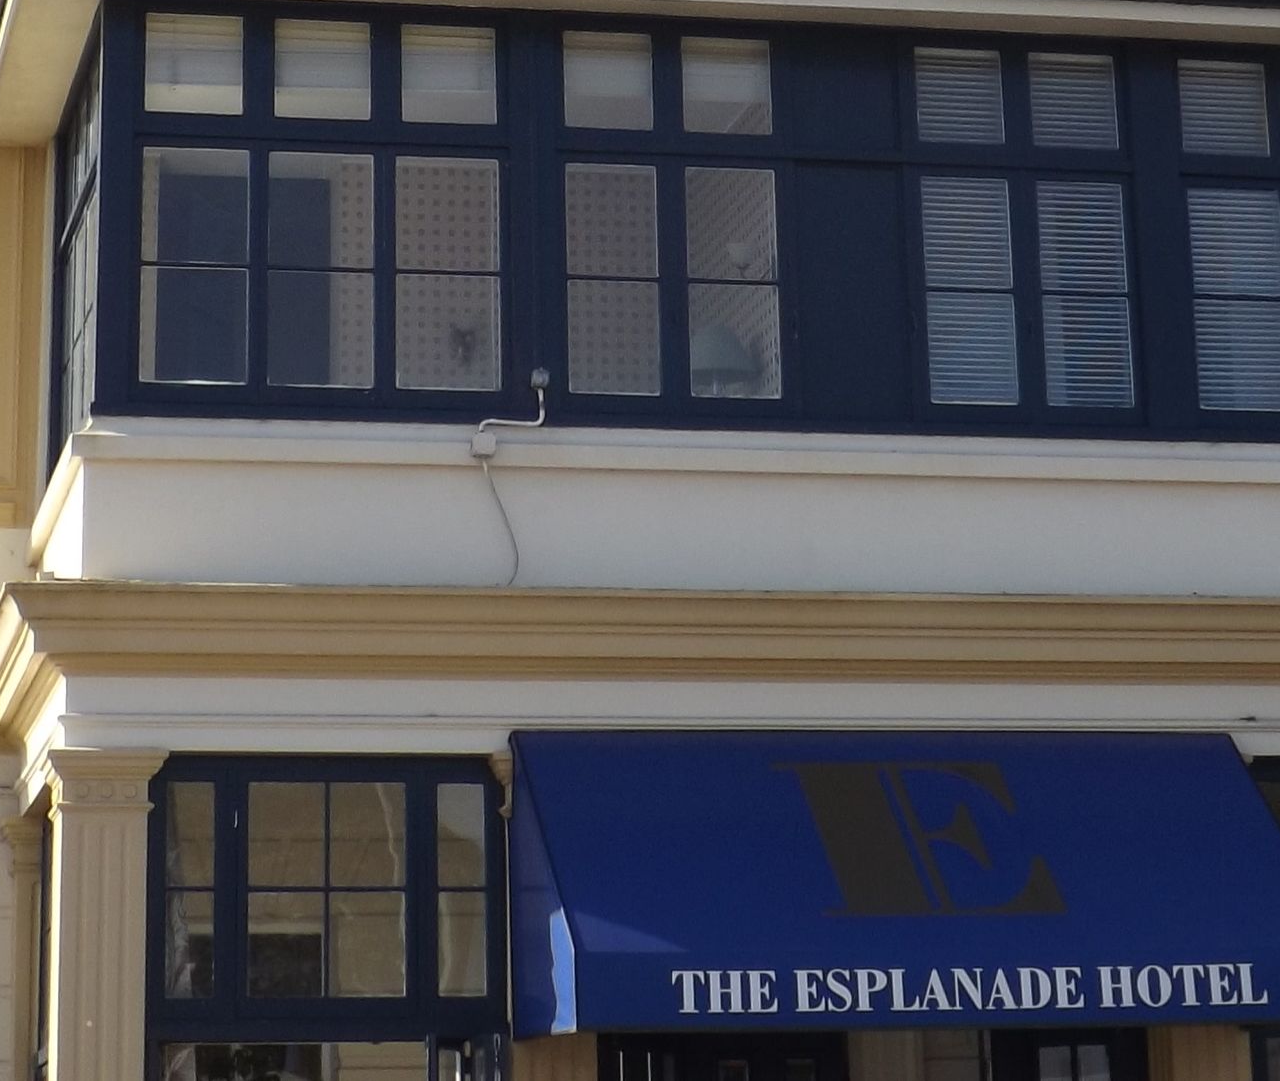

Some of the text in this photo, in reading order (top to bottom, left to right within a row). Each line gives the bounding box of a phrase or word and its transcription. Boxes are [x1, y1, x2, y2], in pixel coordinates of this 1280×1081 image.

[771, 761, 1068, 915] E
[671, 962, 1269, 1014] THE ESPLANADE HOTEL
